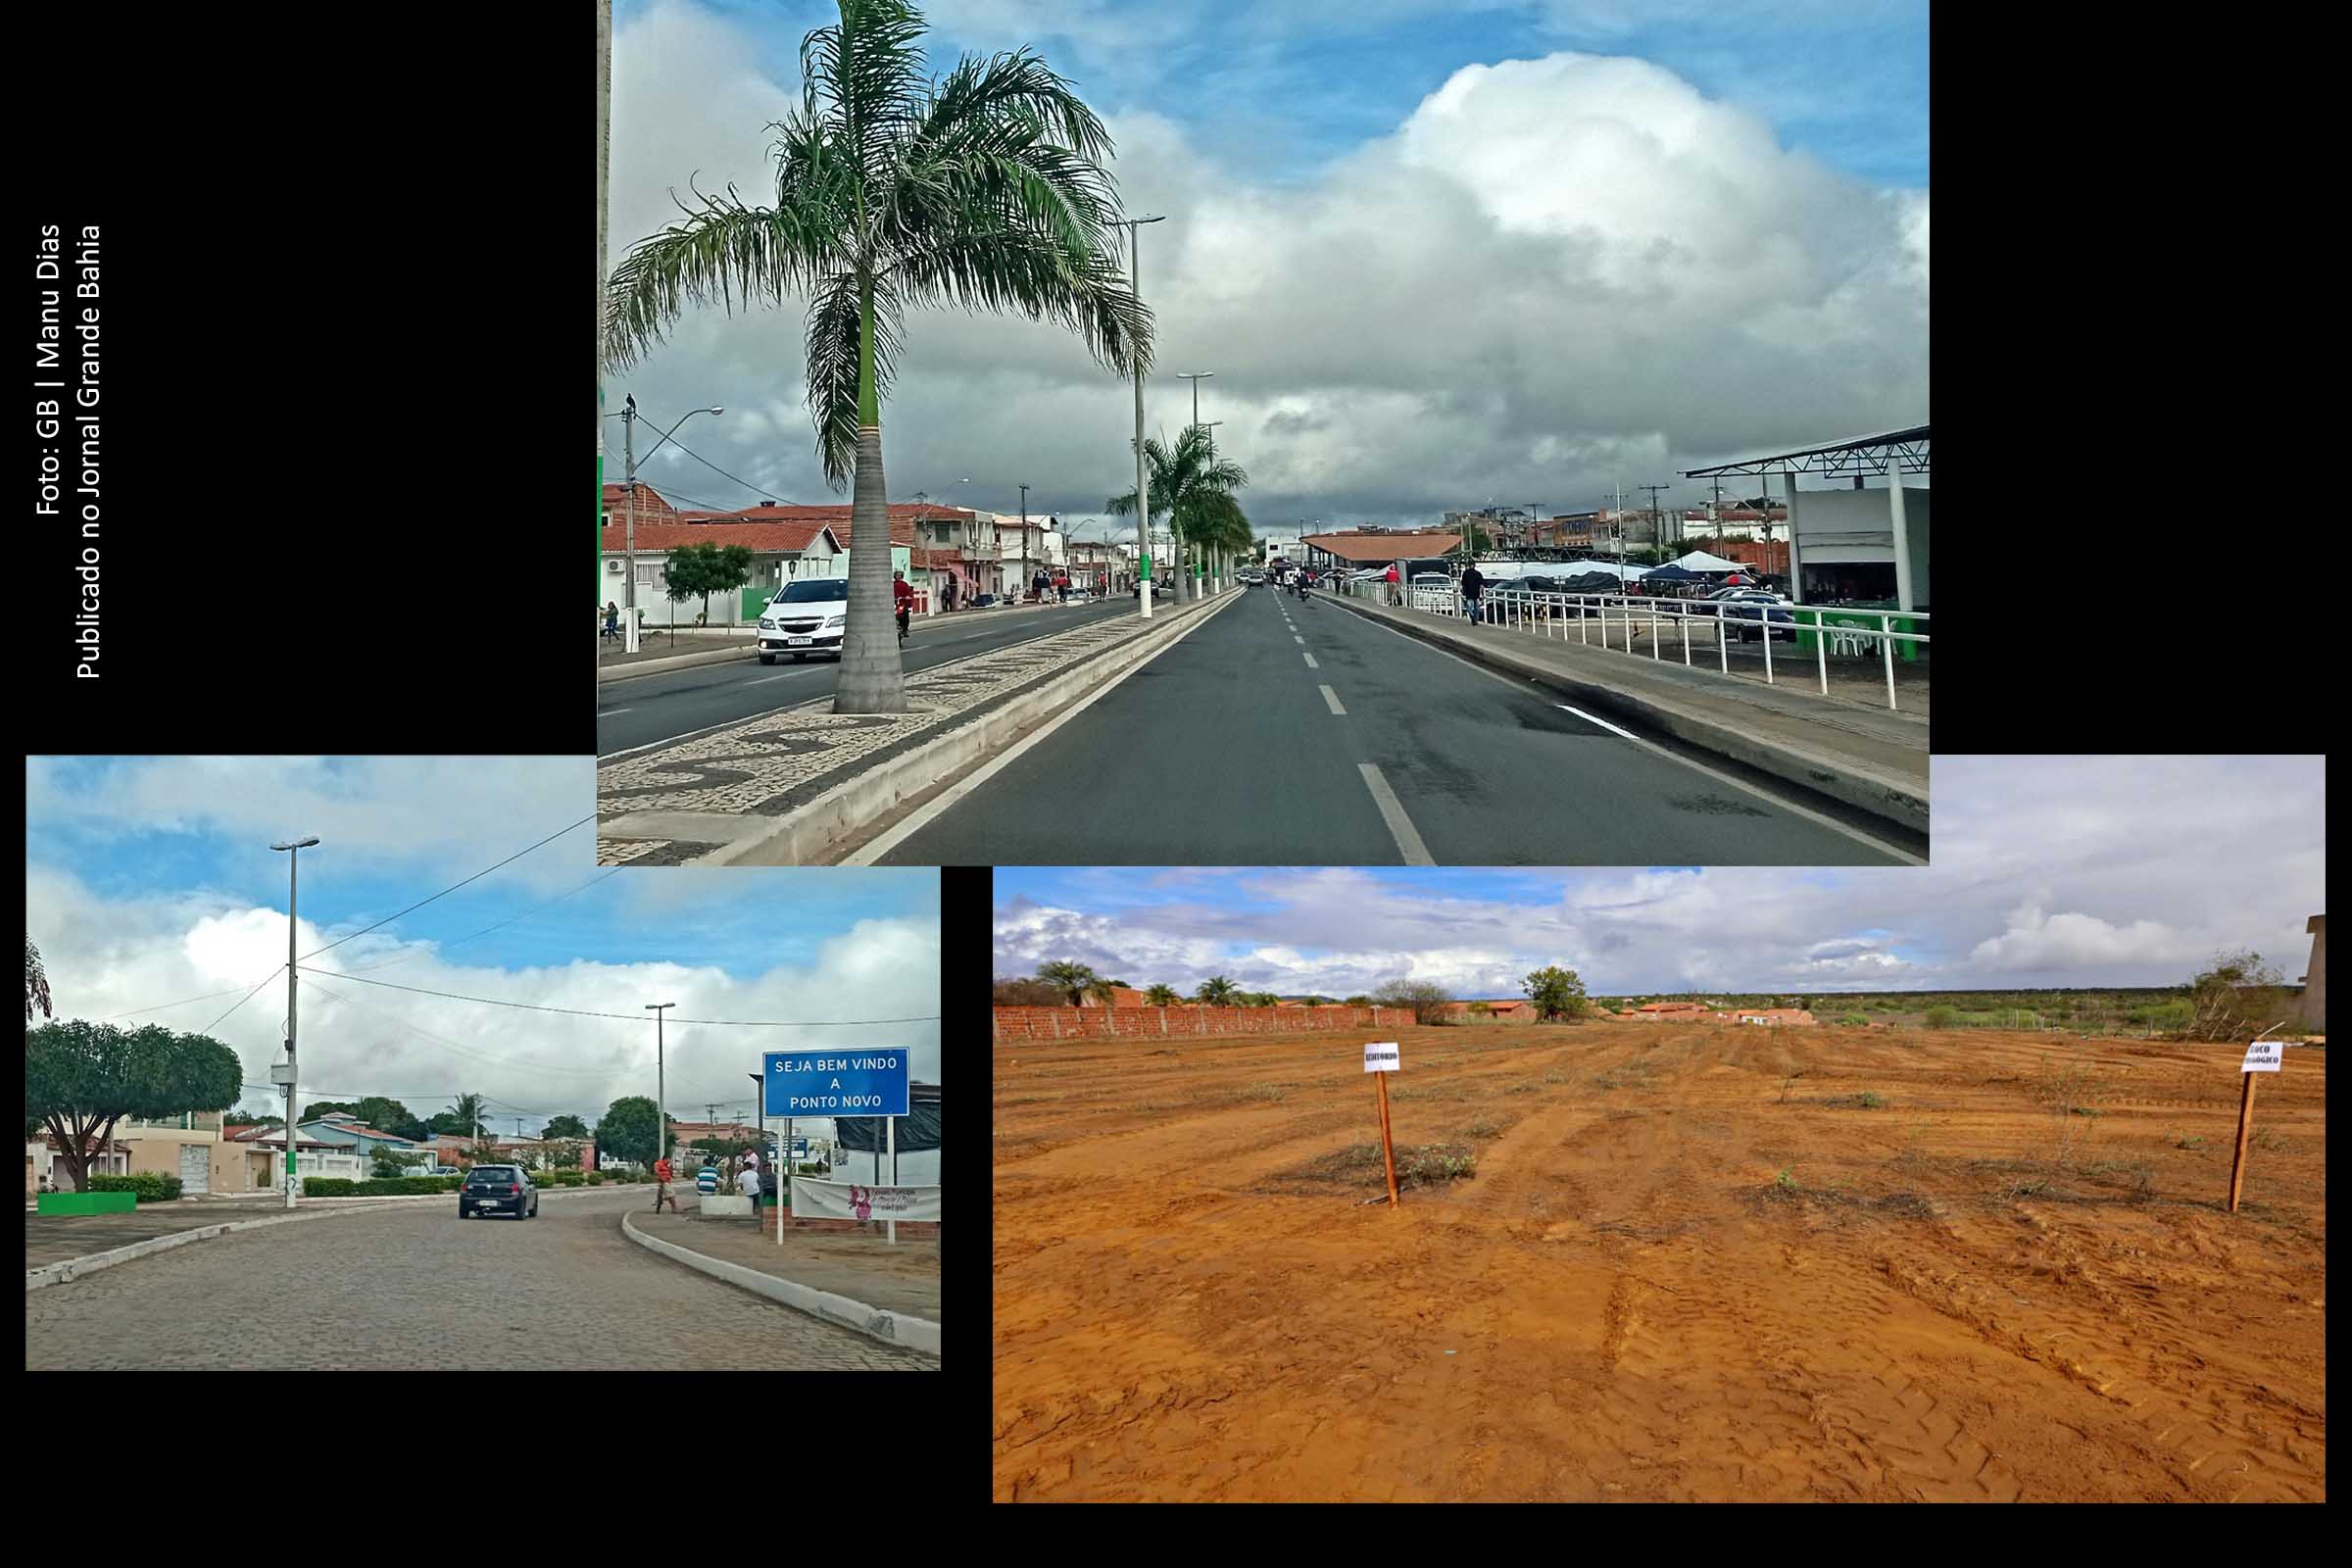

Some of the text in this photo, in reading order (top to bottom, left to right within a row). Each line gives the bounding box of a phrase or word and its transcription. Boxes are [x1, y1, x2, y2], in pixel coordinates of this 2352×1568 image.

[775, 1057, 897, 1073] SEJA BEM VINDO
[830, 1078, 841, 1089] A
[790, 1095, 881, 1108] PONTO NOVO
